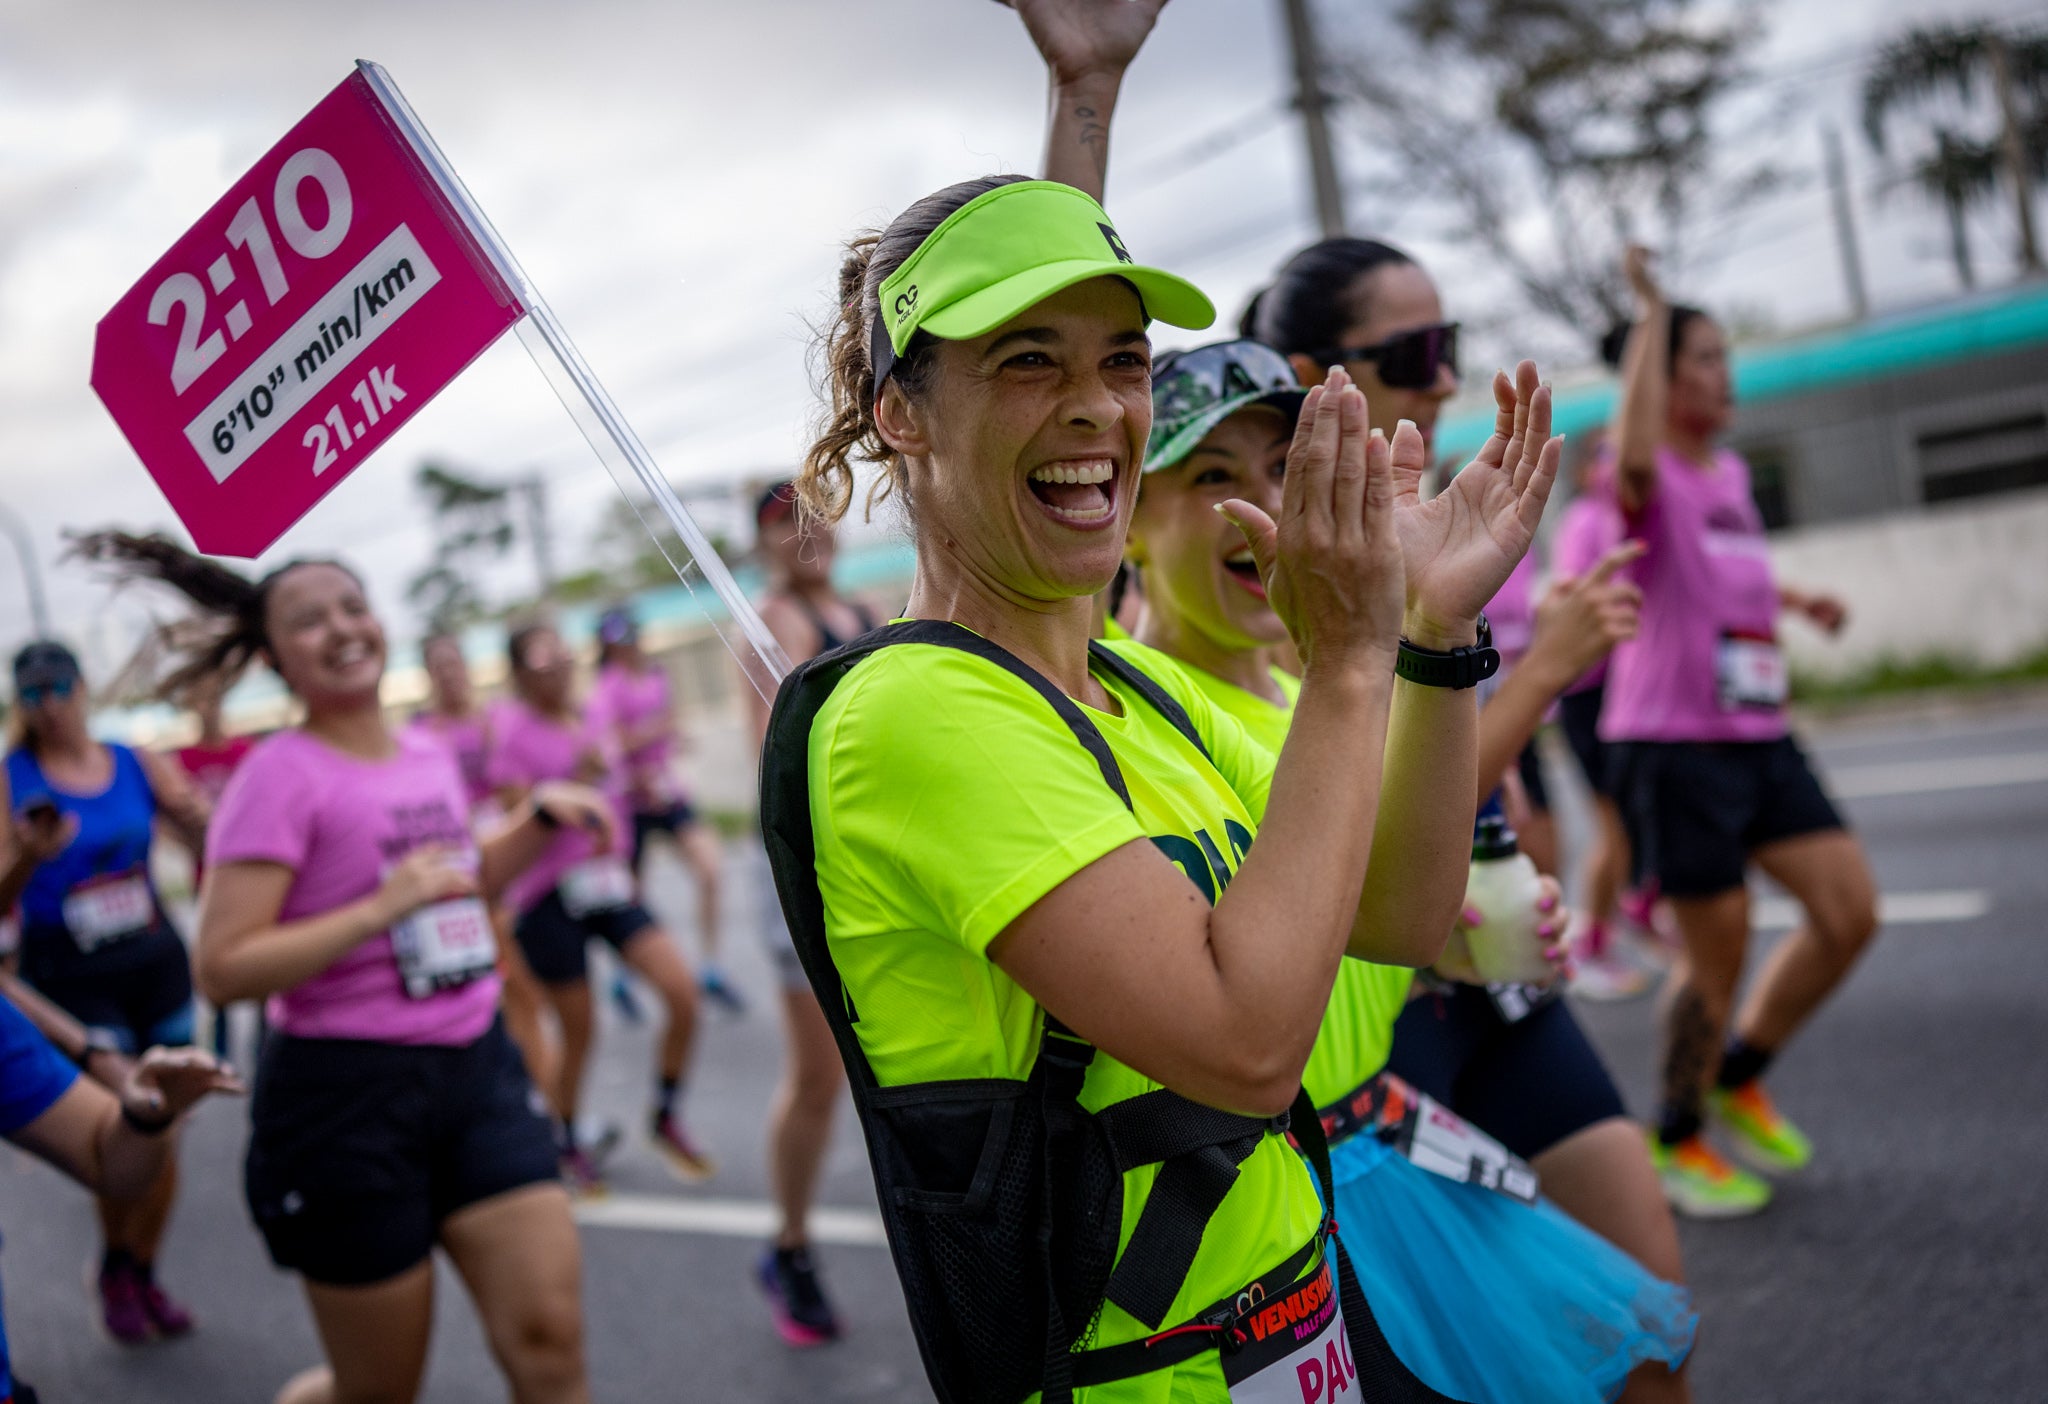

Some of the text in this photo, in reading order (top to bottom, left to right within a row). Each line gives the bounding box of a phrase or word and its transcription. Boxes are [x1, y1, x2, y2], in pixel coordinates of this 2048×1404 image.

[147, 147, 353, 396] 2:10
[298, 257, 417, 382] min/km
[302, 363, 408, 478] 21.1k
[1294, 1313, 1320, 1341] HALF
